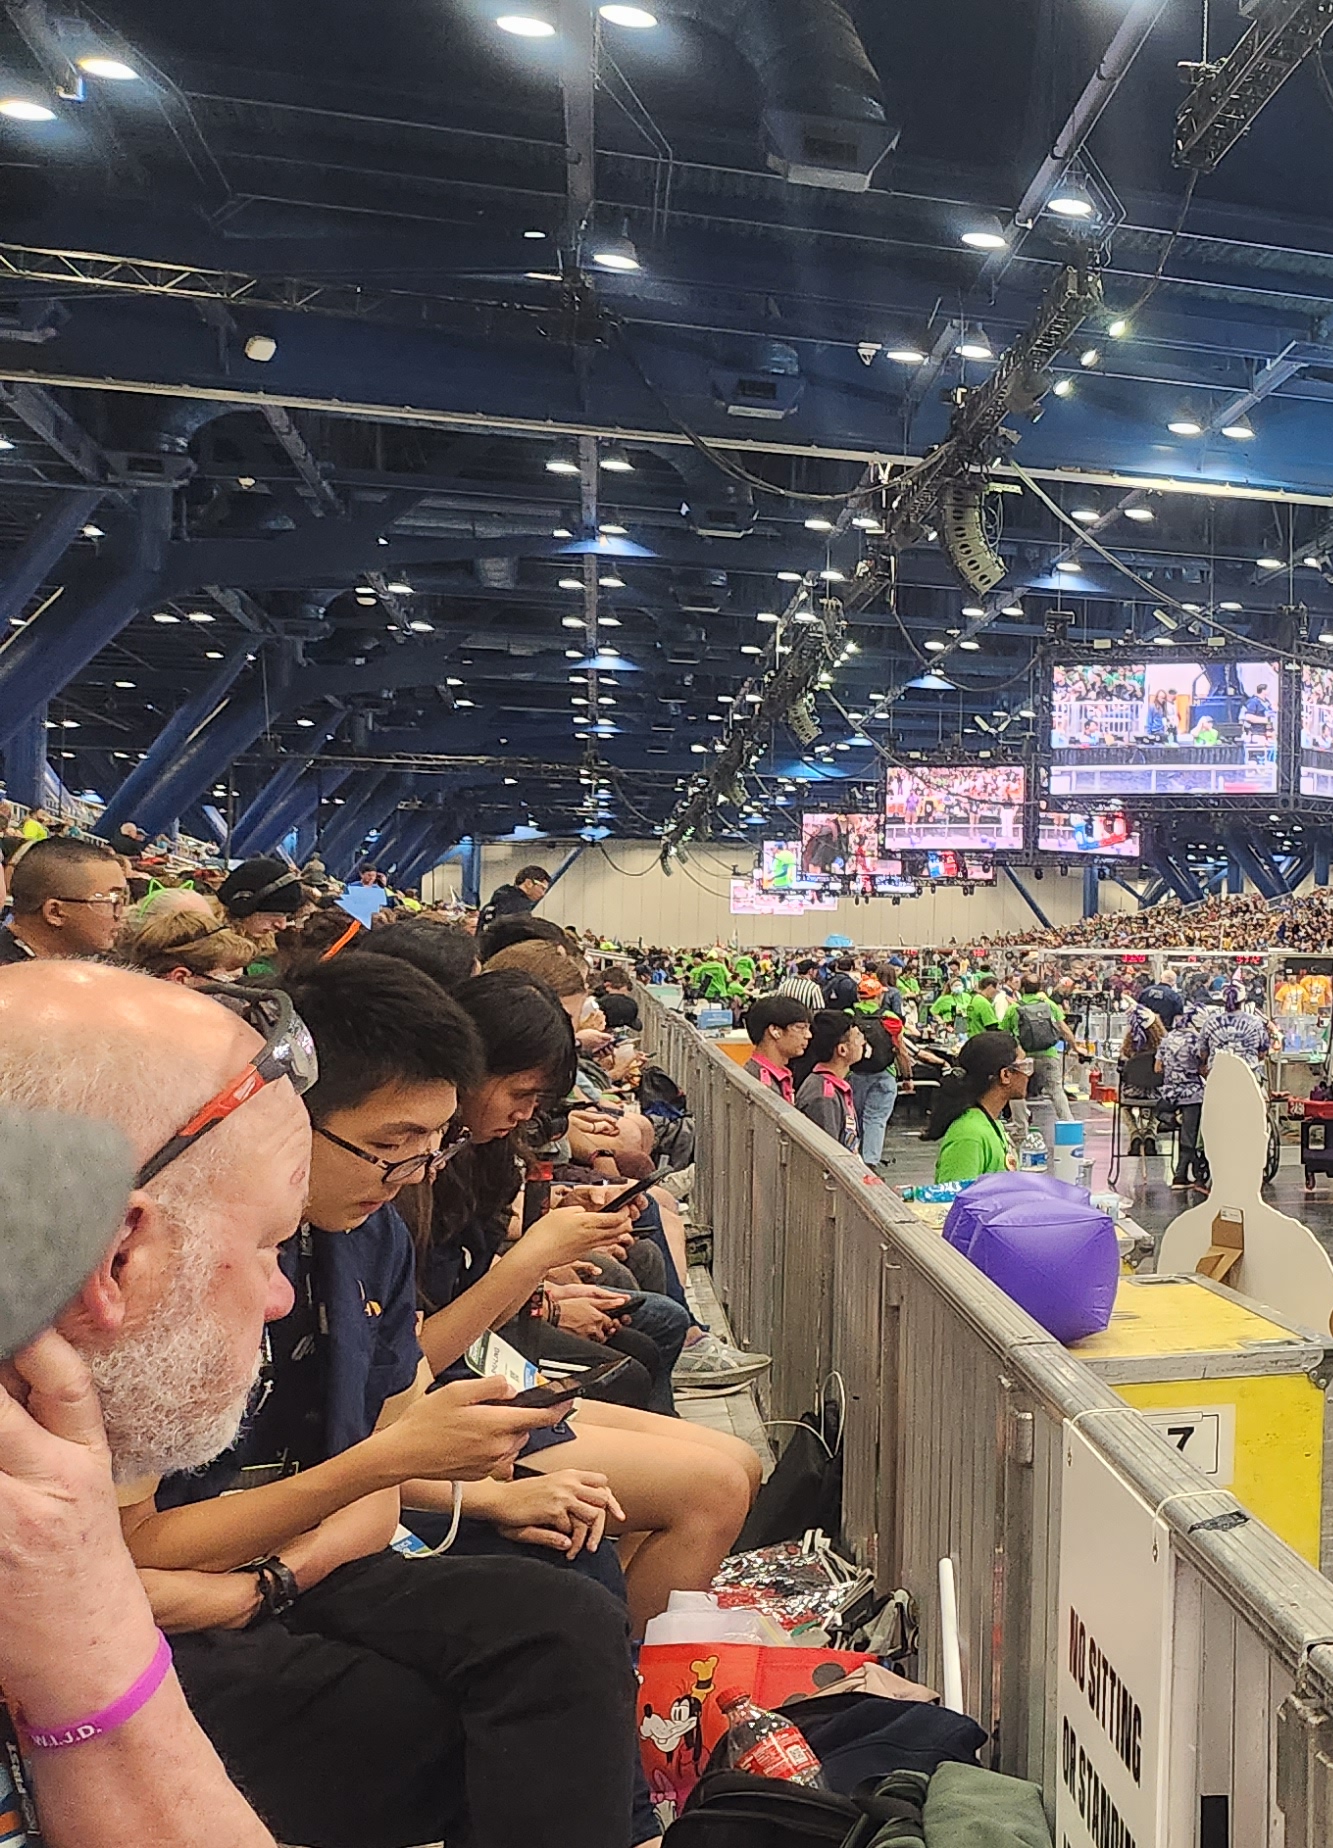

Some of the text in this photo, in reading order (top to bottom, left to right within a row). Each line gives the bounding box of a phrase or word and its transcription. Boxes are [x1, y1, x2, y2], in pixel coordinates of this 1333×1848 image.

[1167, 1426, 1195, 1453] 7
[1069, 1605, 1143, 1790] NO SITTING
[1063, 1715, 1077, 1803] OR
